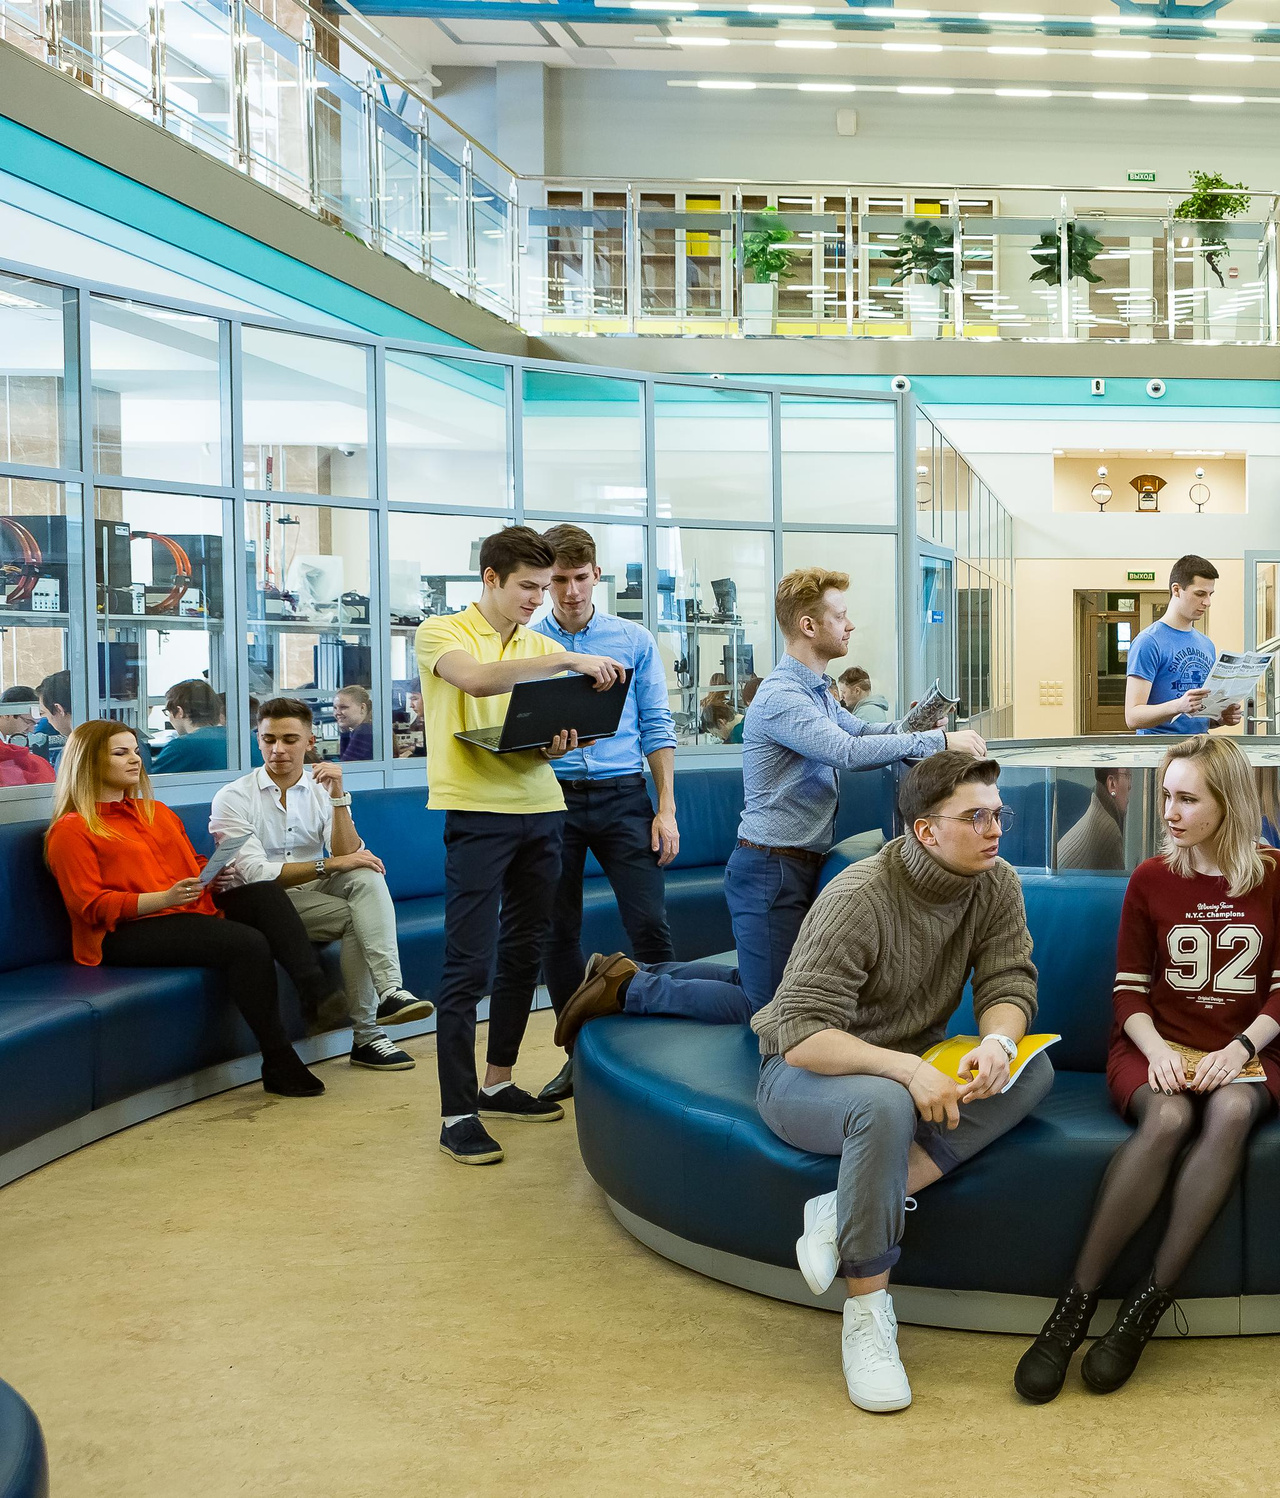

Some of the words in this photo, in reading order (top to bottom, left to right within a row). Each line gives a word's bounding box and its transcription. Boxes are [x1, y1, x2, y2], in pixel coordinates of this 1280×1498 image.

[1129, 173, 1154, 181] ВЫХОД
[1168, 649, 1188, 673] SANTA
[1186, 647, 1211, 666] BARBA
[1164, 923, 1264, 995] 92
